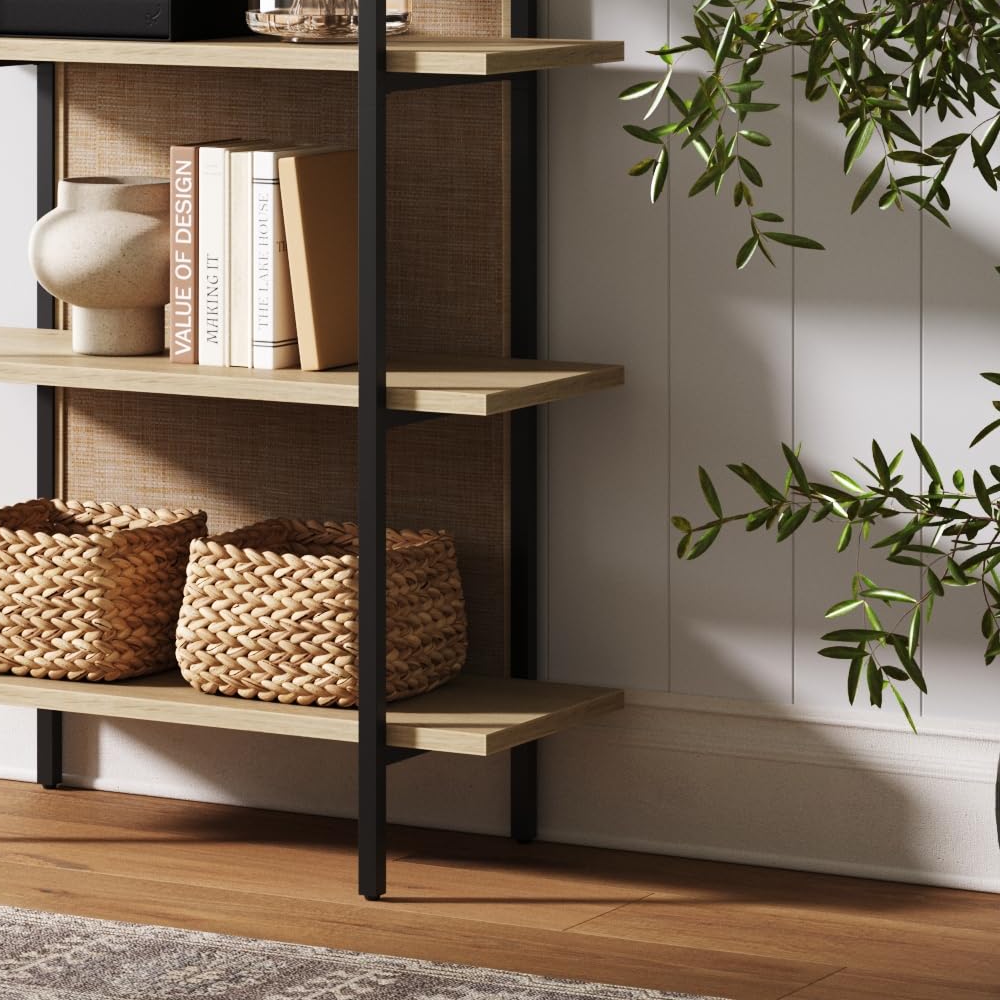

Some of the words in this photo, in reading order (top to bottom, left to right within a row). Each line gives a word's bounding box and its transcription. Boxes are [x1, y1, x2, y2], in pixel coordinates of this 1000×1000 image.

[175, 160, 192, 244] DESIGN
[258, 193, 269, 246] HOUSE
[175, 250, 192, 280] OF
[207, 253, 219, 269] IT
[258, 252, 269, 292] LAKE
[175, 286, 192, 355] VALUE
[207, 275, 219, 344] MAKING
[258, 297, 269, 331] THE
